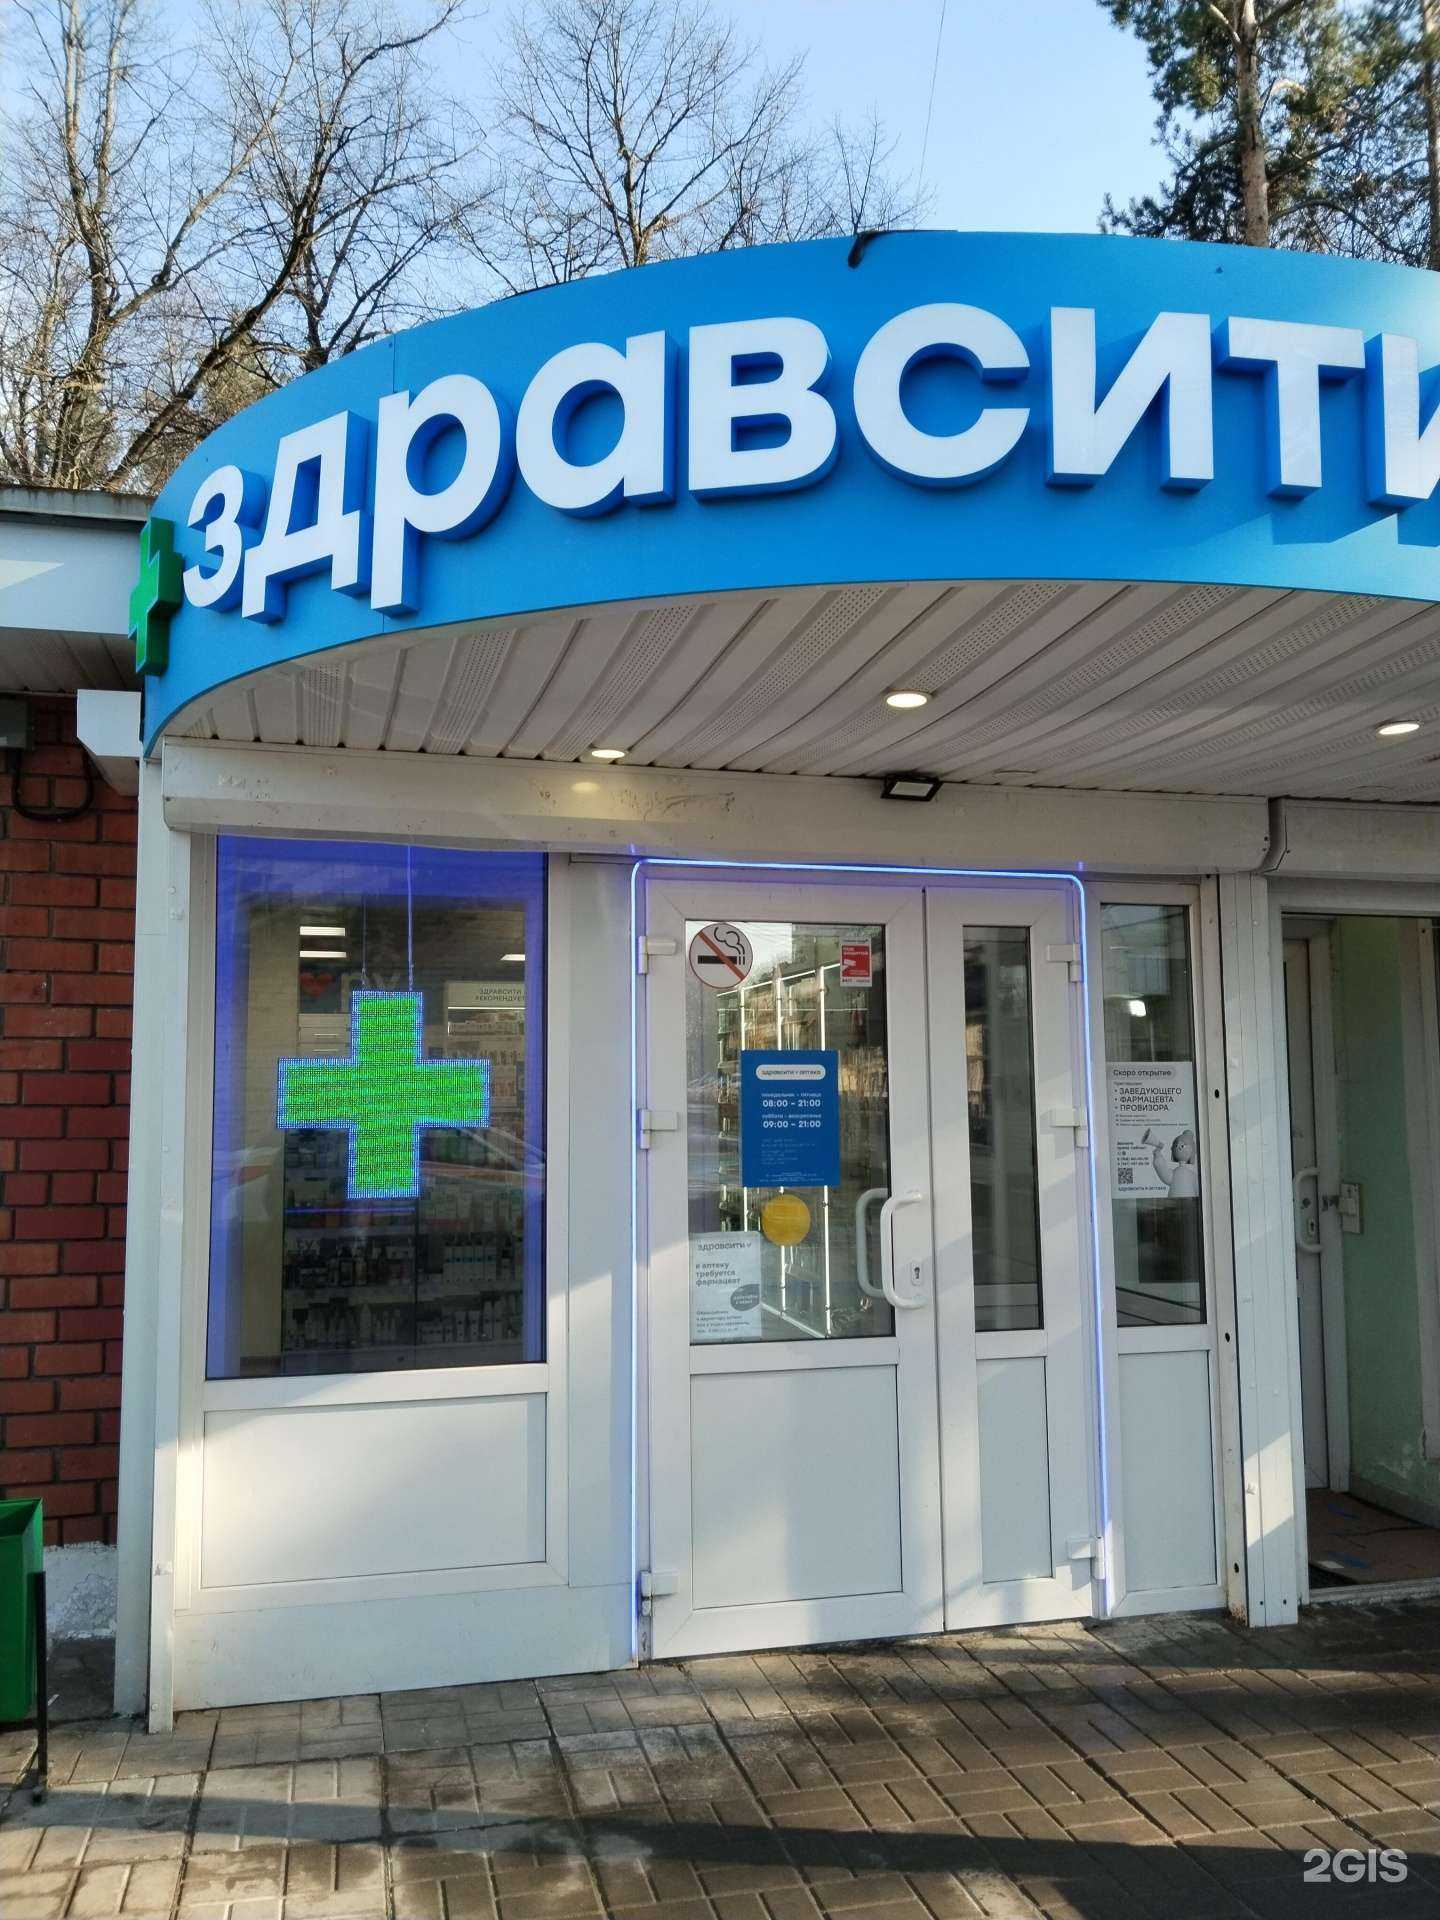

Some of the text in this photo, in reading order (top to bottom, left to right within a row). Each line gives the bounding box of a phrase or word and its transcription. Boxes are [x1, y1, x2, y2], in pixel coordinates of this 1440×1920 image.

[1113, 1069, 1172, 1078] Скоро открытие
[1119, 1087, 1182, 1095] ЗАВЕДУЮЩЕГО
[762, 1099, 788, 1107] 08:00
[798, 1099, 821, 1107] 21:00
[1119, 1096, 1174, 1104] ФАРМАЦЕВТА
[1120, 1104, 1169, 1112] ПРОВИЗОРА
[763, 1120, 789, 1128] 09:00
[798, 1120, 821, 1128] 21:00
[697, 1242, 746, 1251] здравсити
[702, 1262, 729, 1270] аптеку
[695, 1269, 736, 1278] требуется
[695, 1278, 741, 1287] фармацевт
